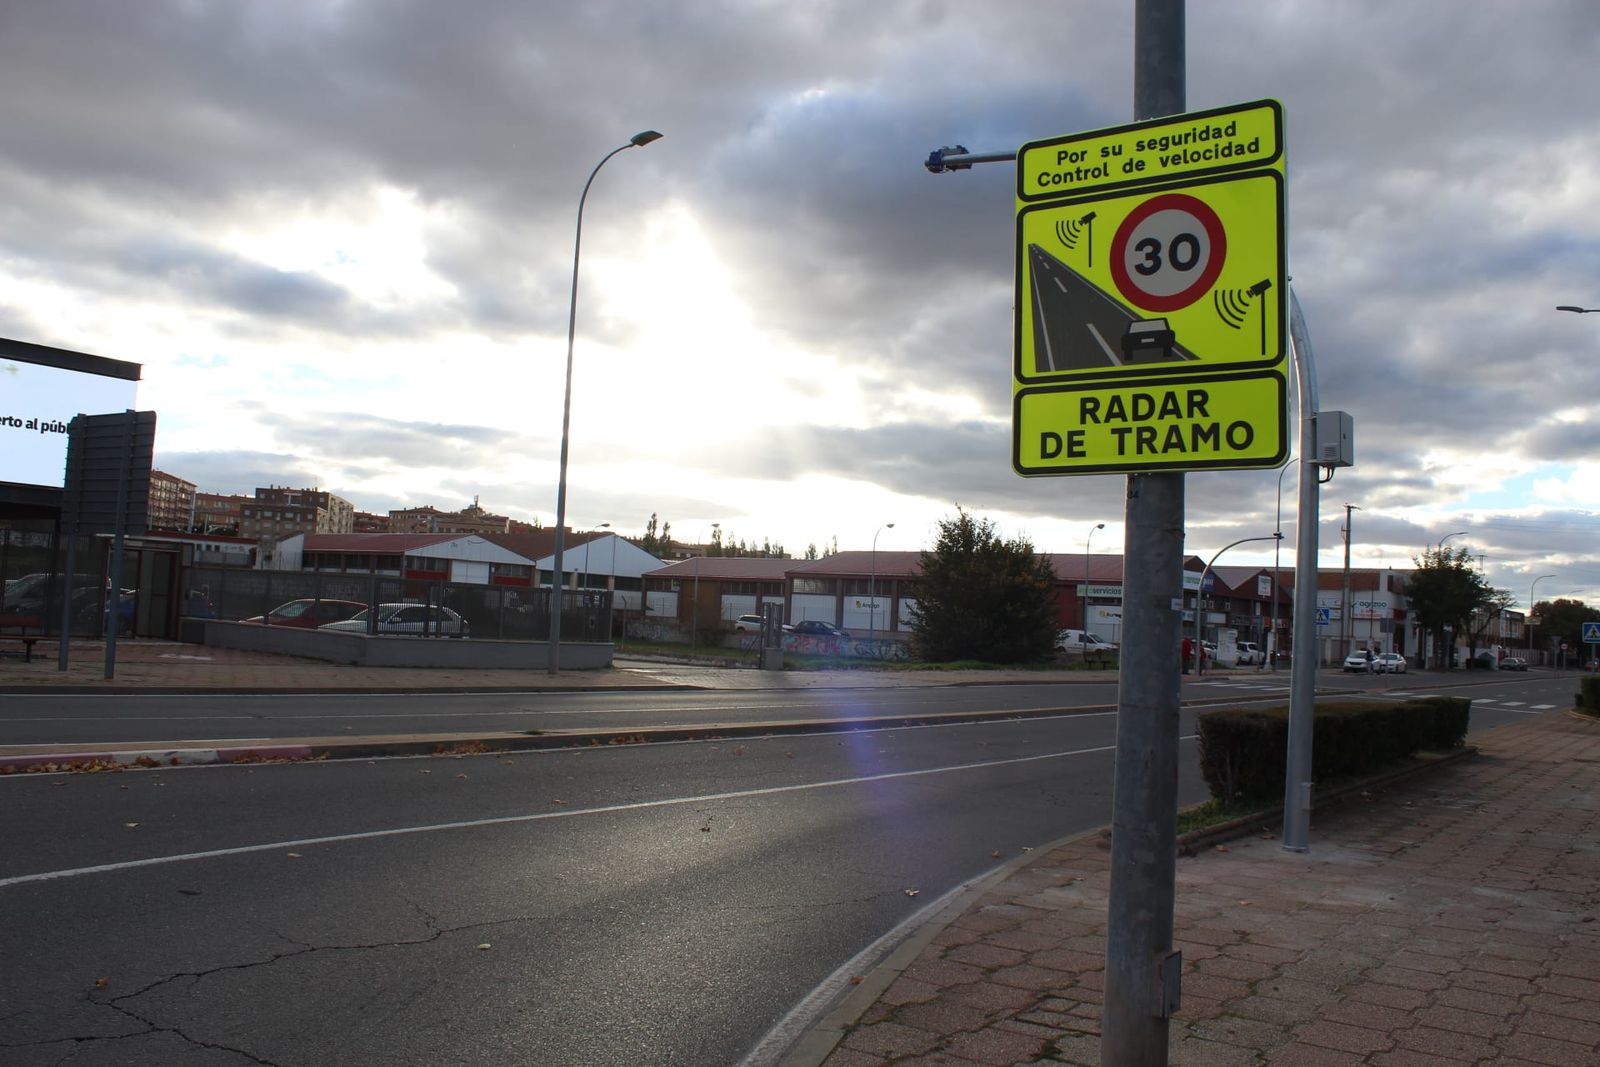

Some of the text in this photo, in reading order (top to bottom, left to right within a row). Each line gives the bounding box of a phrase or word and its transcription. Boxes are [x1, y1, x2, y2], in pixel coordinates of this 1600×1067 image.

[1037, 137, 1260, 187] Control de velocidad
[1057, 121, 1237, 166] Por su seguridad
[1134, 232, 1200, 276] 30
[25, 418, 38, 430] al
[1079, 389, 1210, 425] RADAR
[1040, 420, 1255, 460] DE TRAMO
